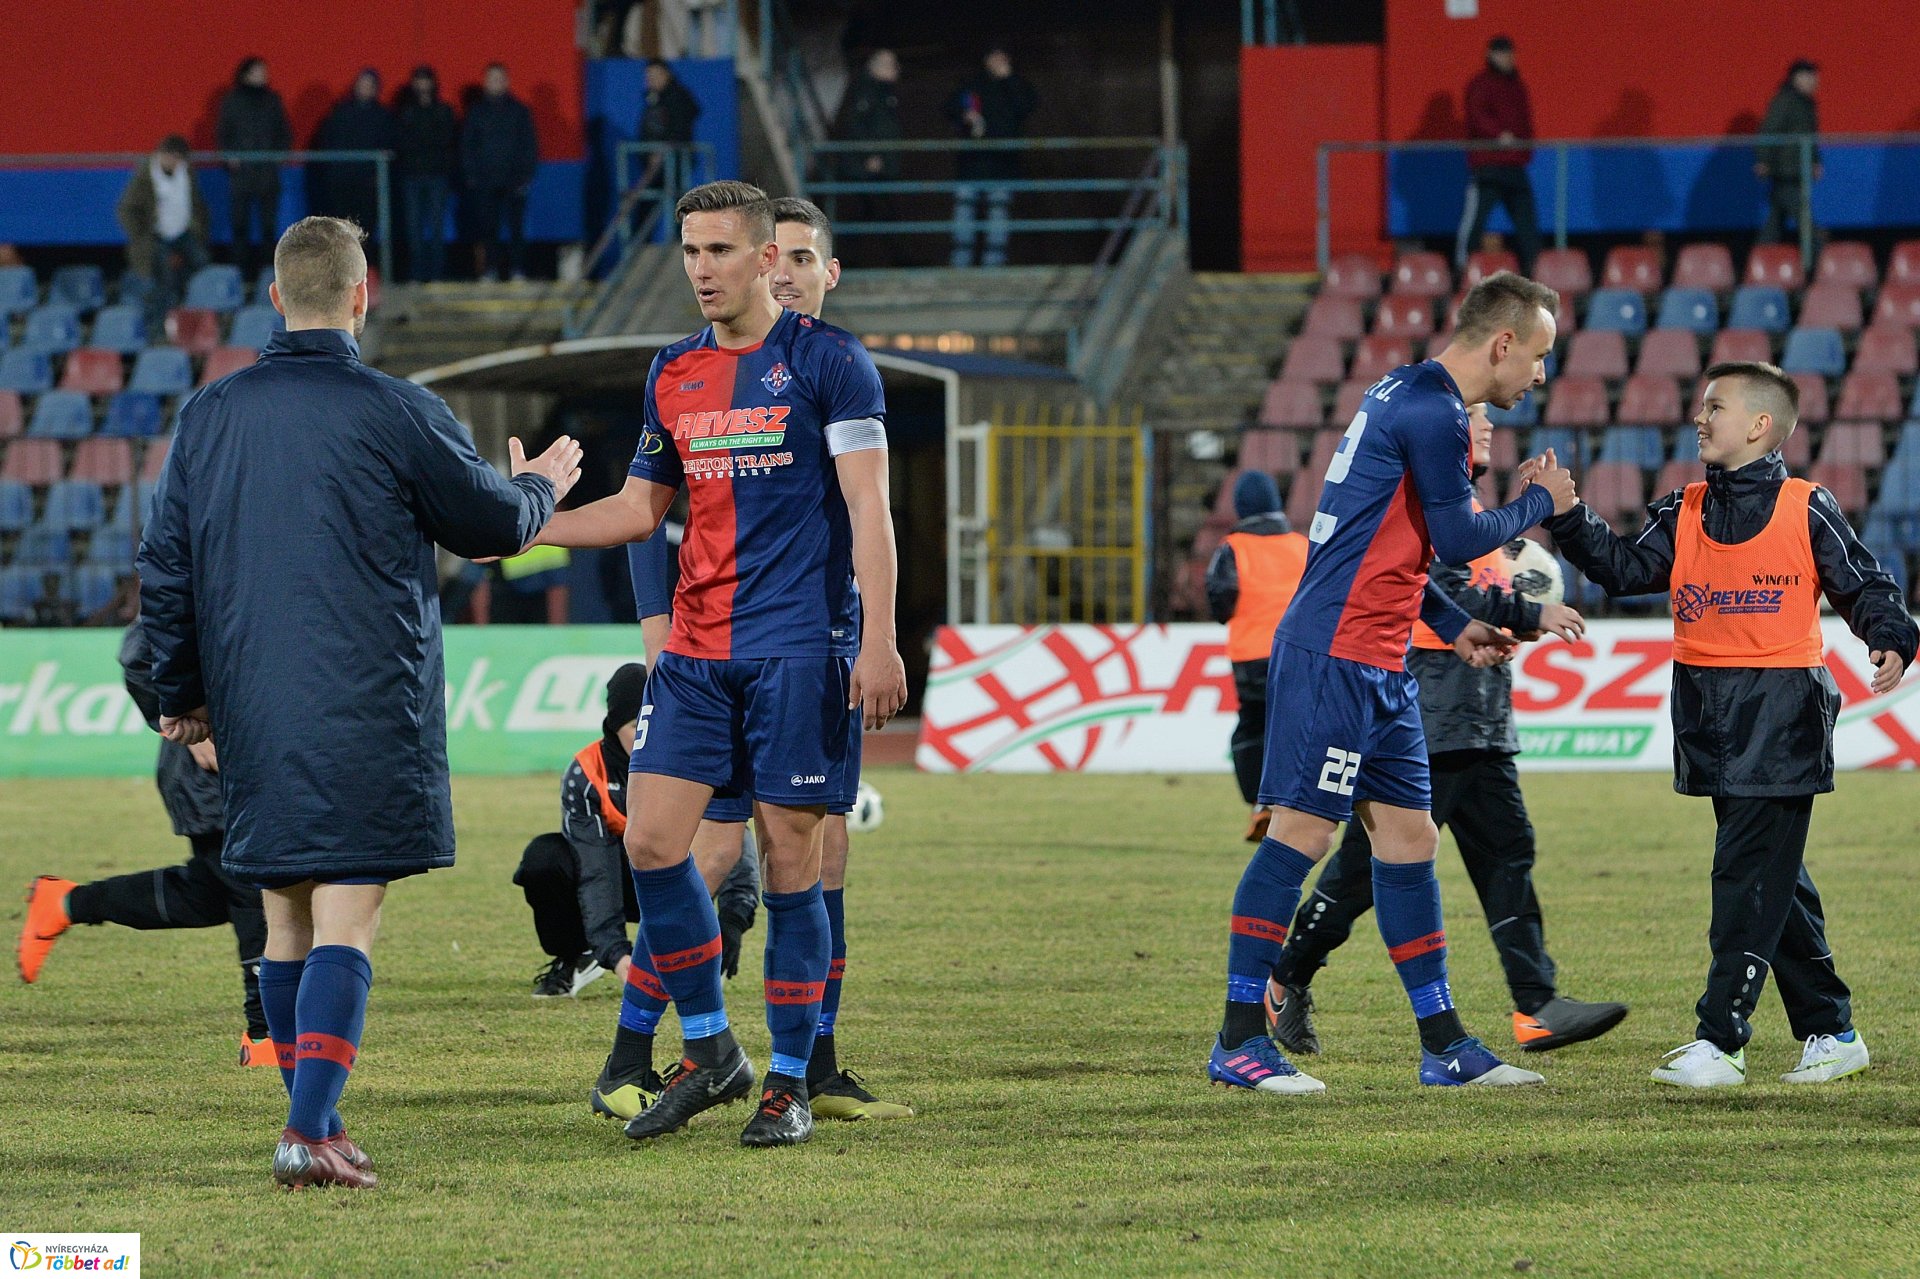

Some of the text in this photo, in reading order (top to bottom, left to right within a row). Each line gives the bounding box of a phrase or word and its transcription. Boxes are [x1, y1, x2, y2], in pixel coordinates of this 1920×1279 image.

[674, 406, 791, 440] REVESZ
[691, 440, 717, 449] ALWAYS
[742, 437, 762, 445] RIGHT
[682, 452, 794, 474] ERTON TRANS
[695, 467, 772, 480] HUNGARY
[1710, 589, 1784, 606] REVESZ
[1572, 729, 1643, 756] WAY
[804, 774, 826, 784] JAKO
[1317, 746, 1361, 796] 22
